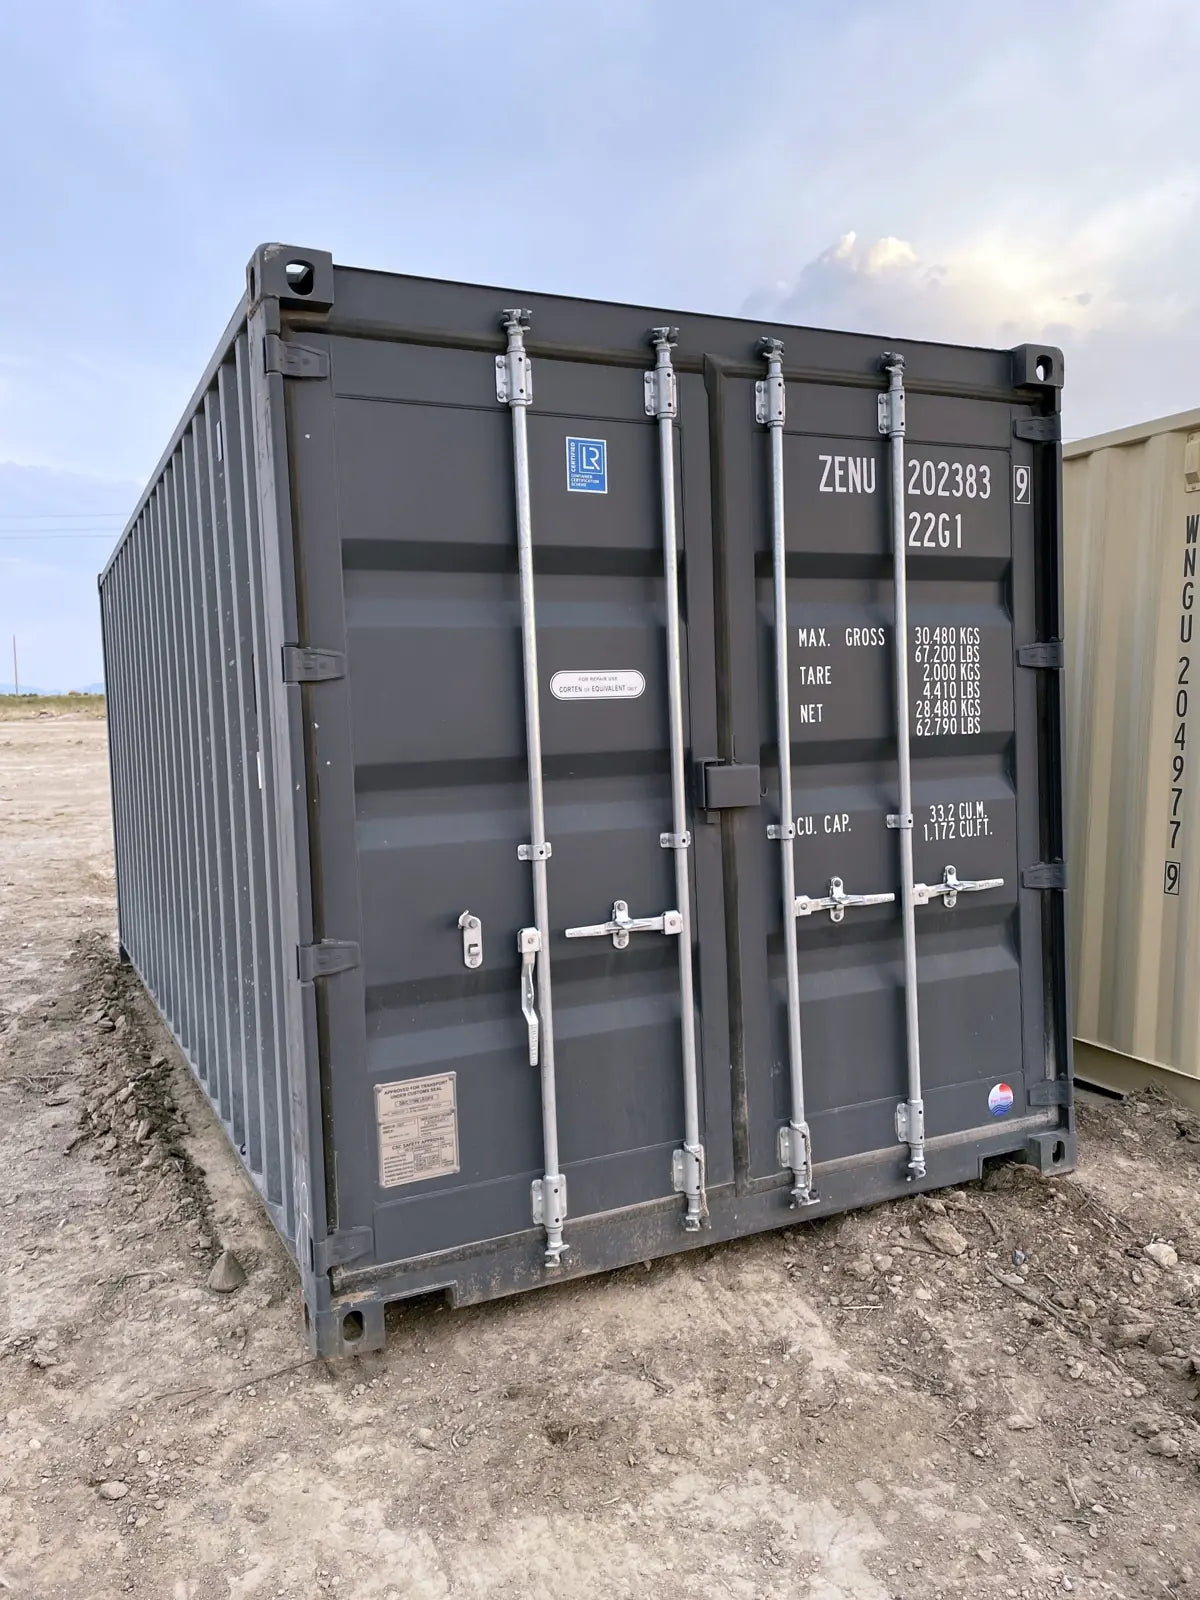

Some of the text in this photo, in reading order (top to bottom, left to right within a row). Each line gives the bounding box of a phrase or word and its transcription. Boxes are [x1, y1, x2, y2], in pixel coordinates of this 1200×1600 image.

[582, 446, 601, 470] LR
[818, 455, 1028, 501] ZENU 202383 9
[908, 511, 962, 549] 22G1
[798, 627, 981, 647] MAX. GROSS 30,480 KGS
[914, 645, 980, 664] 67,200 LBS
[799, 663, 981, 685] TARE 2,000 KGS
[923, 681, 981, 700] 4,410 LBS
[800, 699, 981, 723] NET 28,480 KGS
[1166, 514, 1200, 891] WNGU 204977 9
[916, 717, 981, 736] 62,790 LBS
[797, 801, 988, 835] CU. CAP. 33.2 CU.M.
[923, 818, 993, 841] 1,172 CU.FT.
[384, 1087, 410, 1095] APPROVED
[421, 1080, 448, 1088] TRANSPORT
[408, 1088, 430, 1096] CUSTOMS
[403, 1140, 420, 1148] SAFETY
